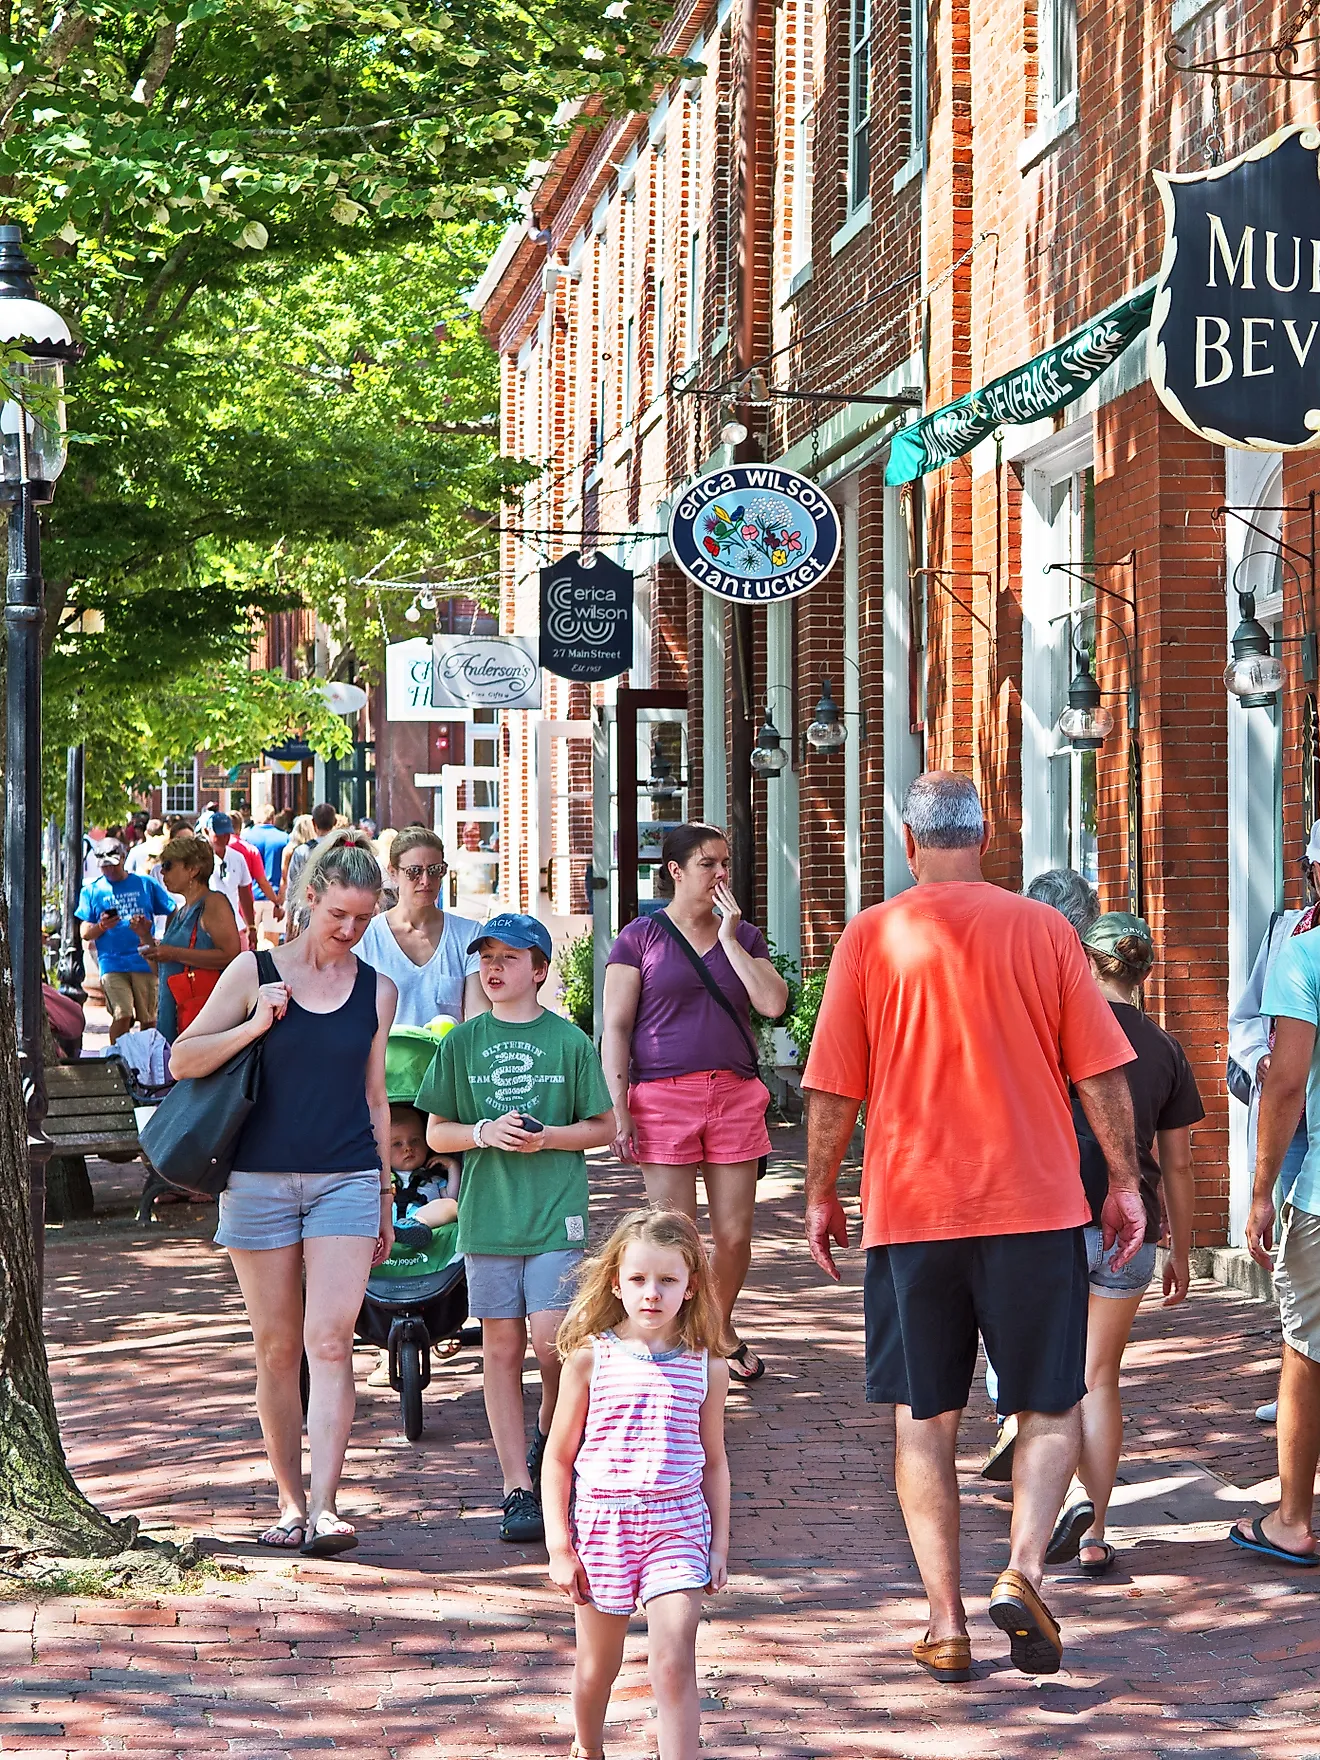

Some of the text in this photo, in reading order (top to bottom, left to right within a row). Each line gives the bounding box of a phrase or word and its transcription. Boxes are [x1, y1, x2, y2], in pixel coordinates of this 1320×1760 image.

[985, 353, 1073, 424] BEVERAGE
[689, 556, 825, 599] nantucket
[573, 585, 617, 601] erica
[573, 604, 628, 621] wilson
[552, 648, 566, 658] 27
[443, 652, 532, 691] Anderson's
[489, 919, 513, 928] ACK
[482, 1041, 543, 1058] SLYTHERIN
[398, 1257, 420, 1267] jogger
